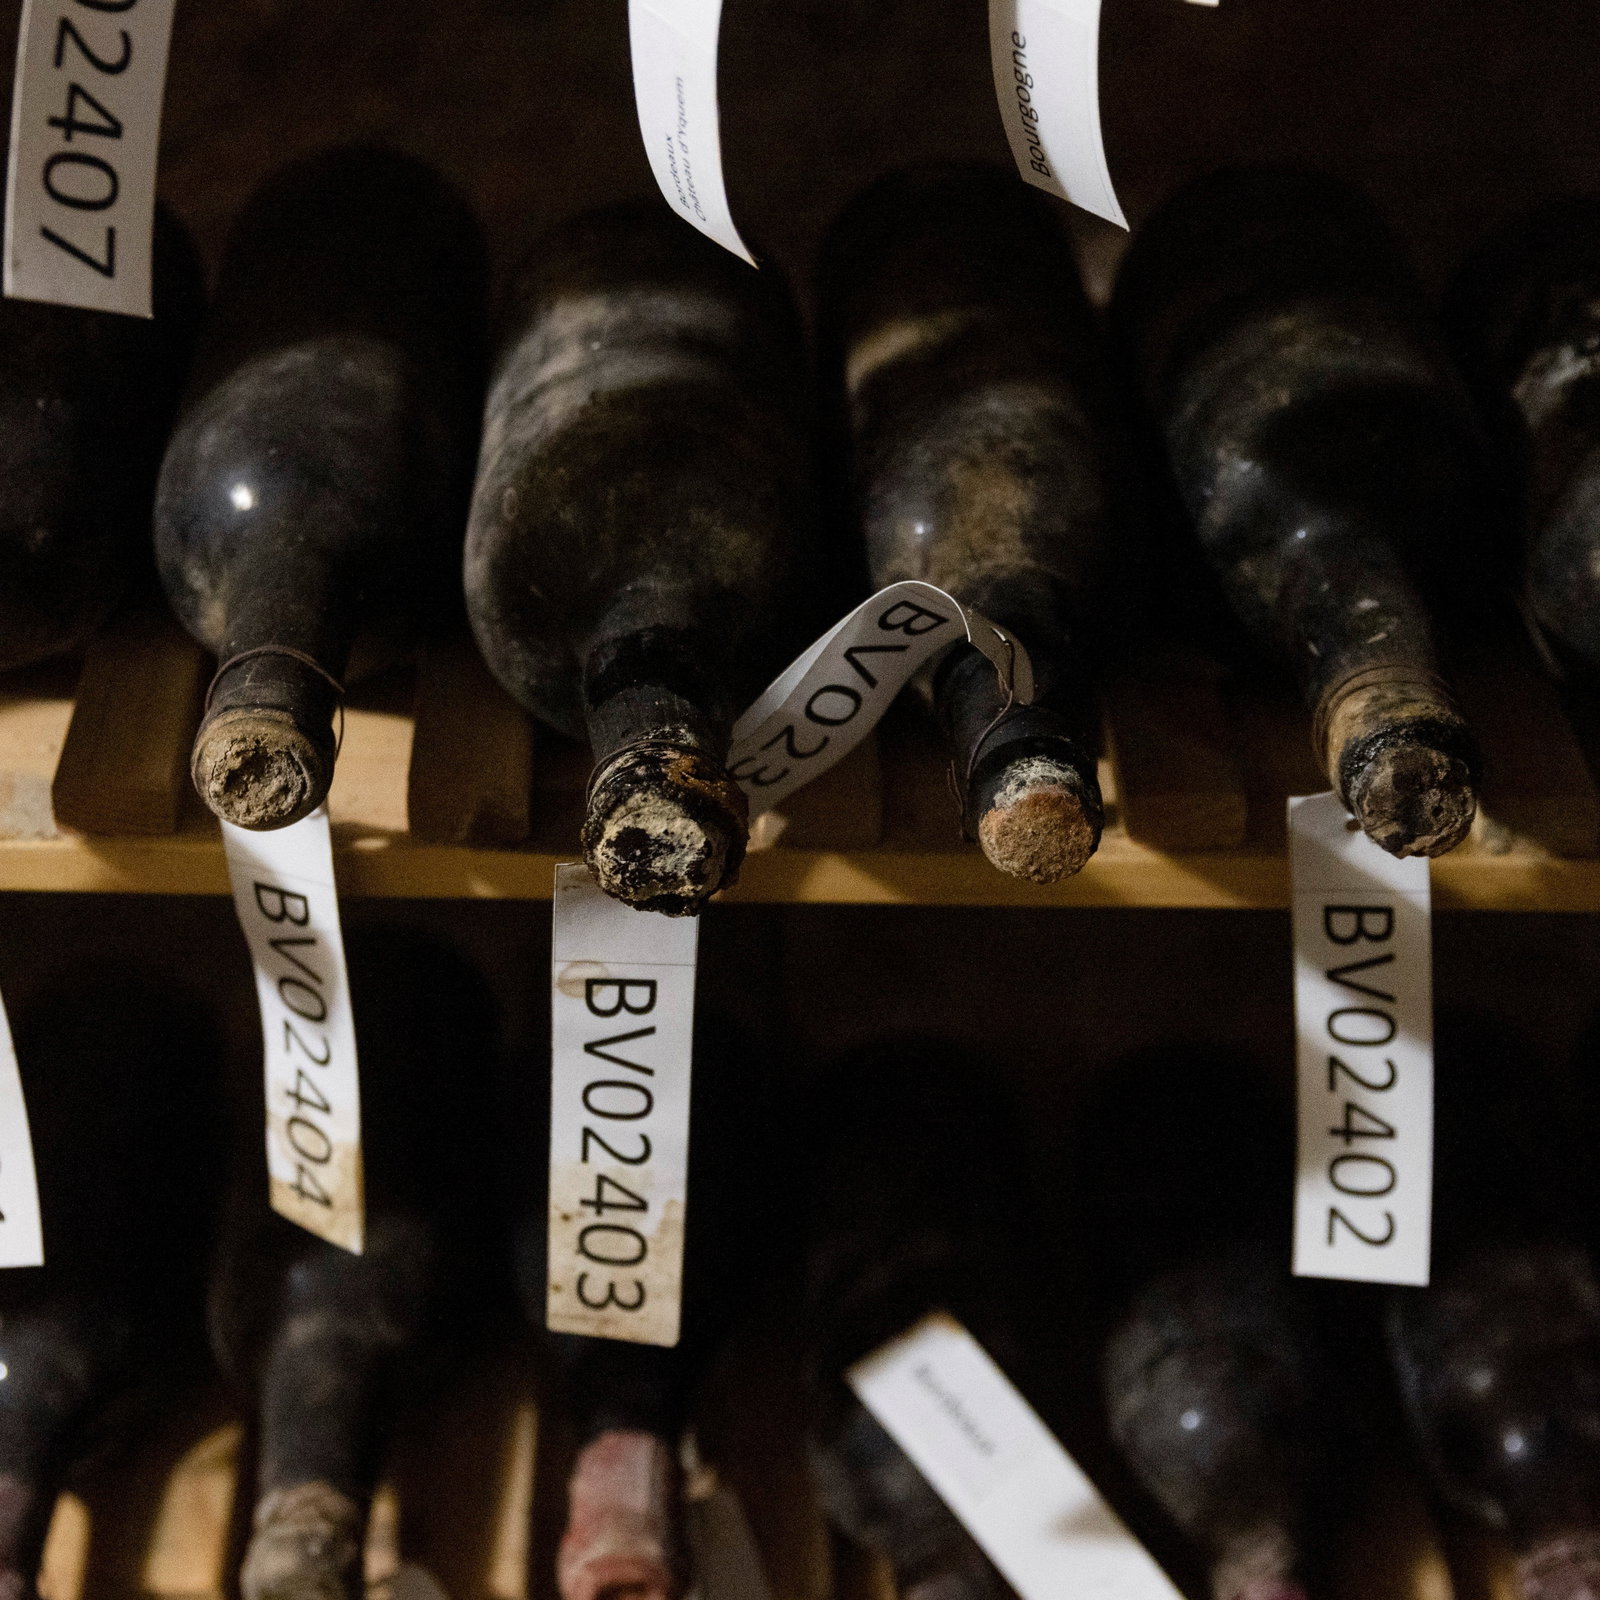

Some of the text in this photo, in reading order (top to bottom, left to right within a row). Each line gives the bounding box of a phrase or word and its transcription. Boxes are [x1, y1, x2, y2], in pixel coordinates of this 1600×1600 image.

[40, 0, 138, 279] 2407
[665, 132, 690, 210] Bordeaux
[681, 157, 706, 222] Château
[1011, 30, 1051, 179] Bourgogne
[253, 880, 333, 1210] BV02404
[575, 978, 658, 1313] BV02403
[1323, 904, 1398, 1248] BV02402
